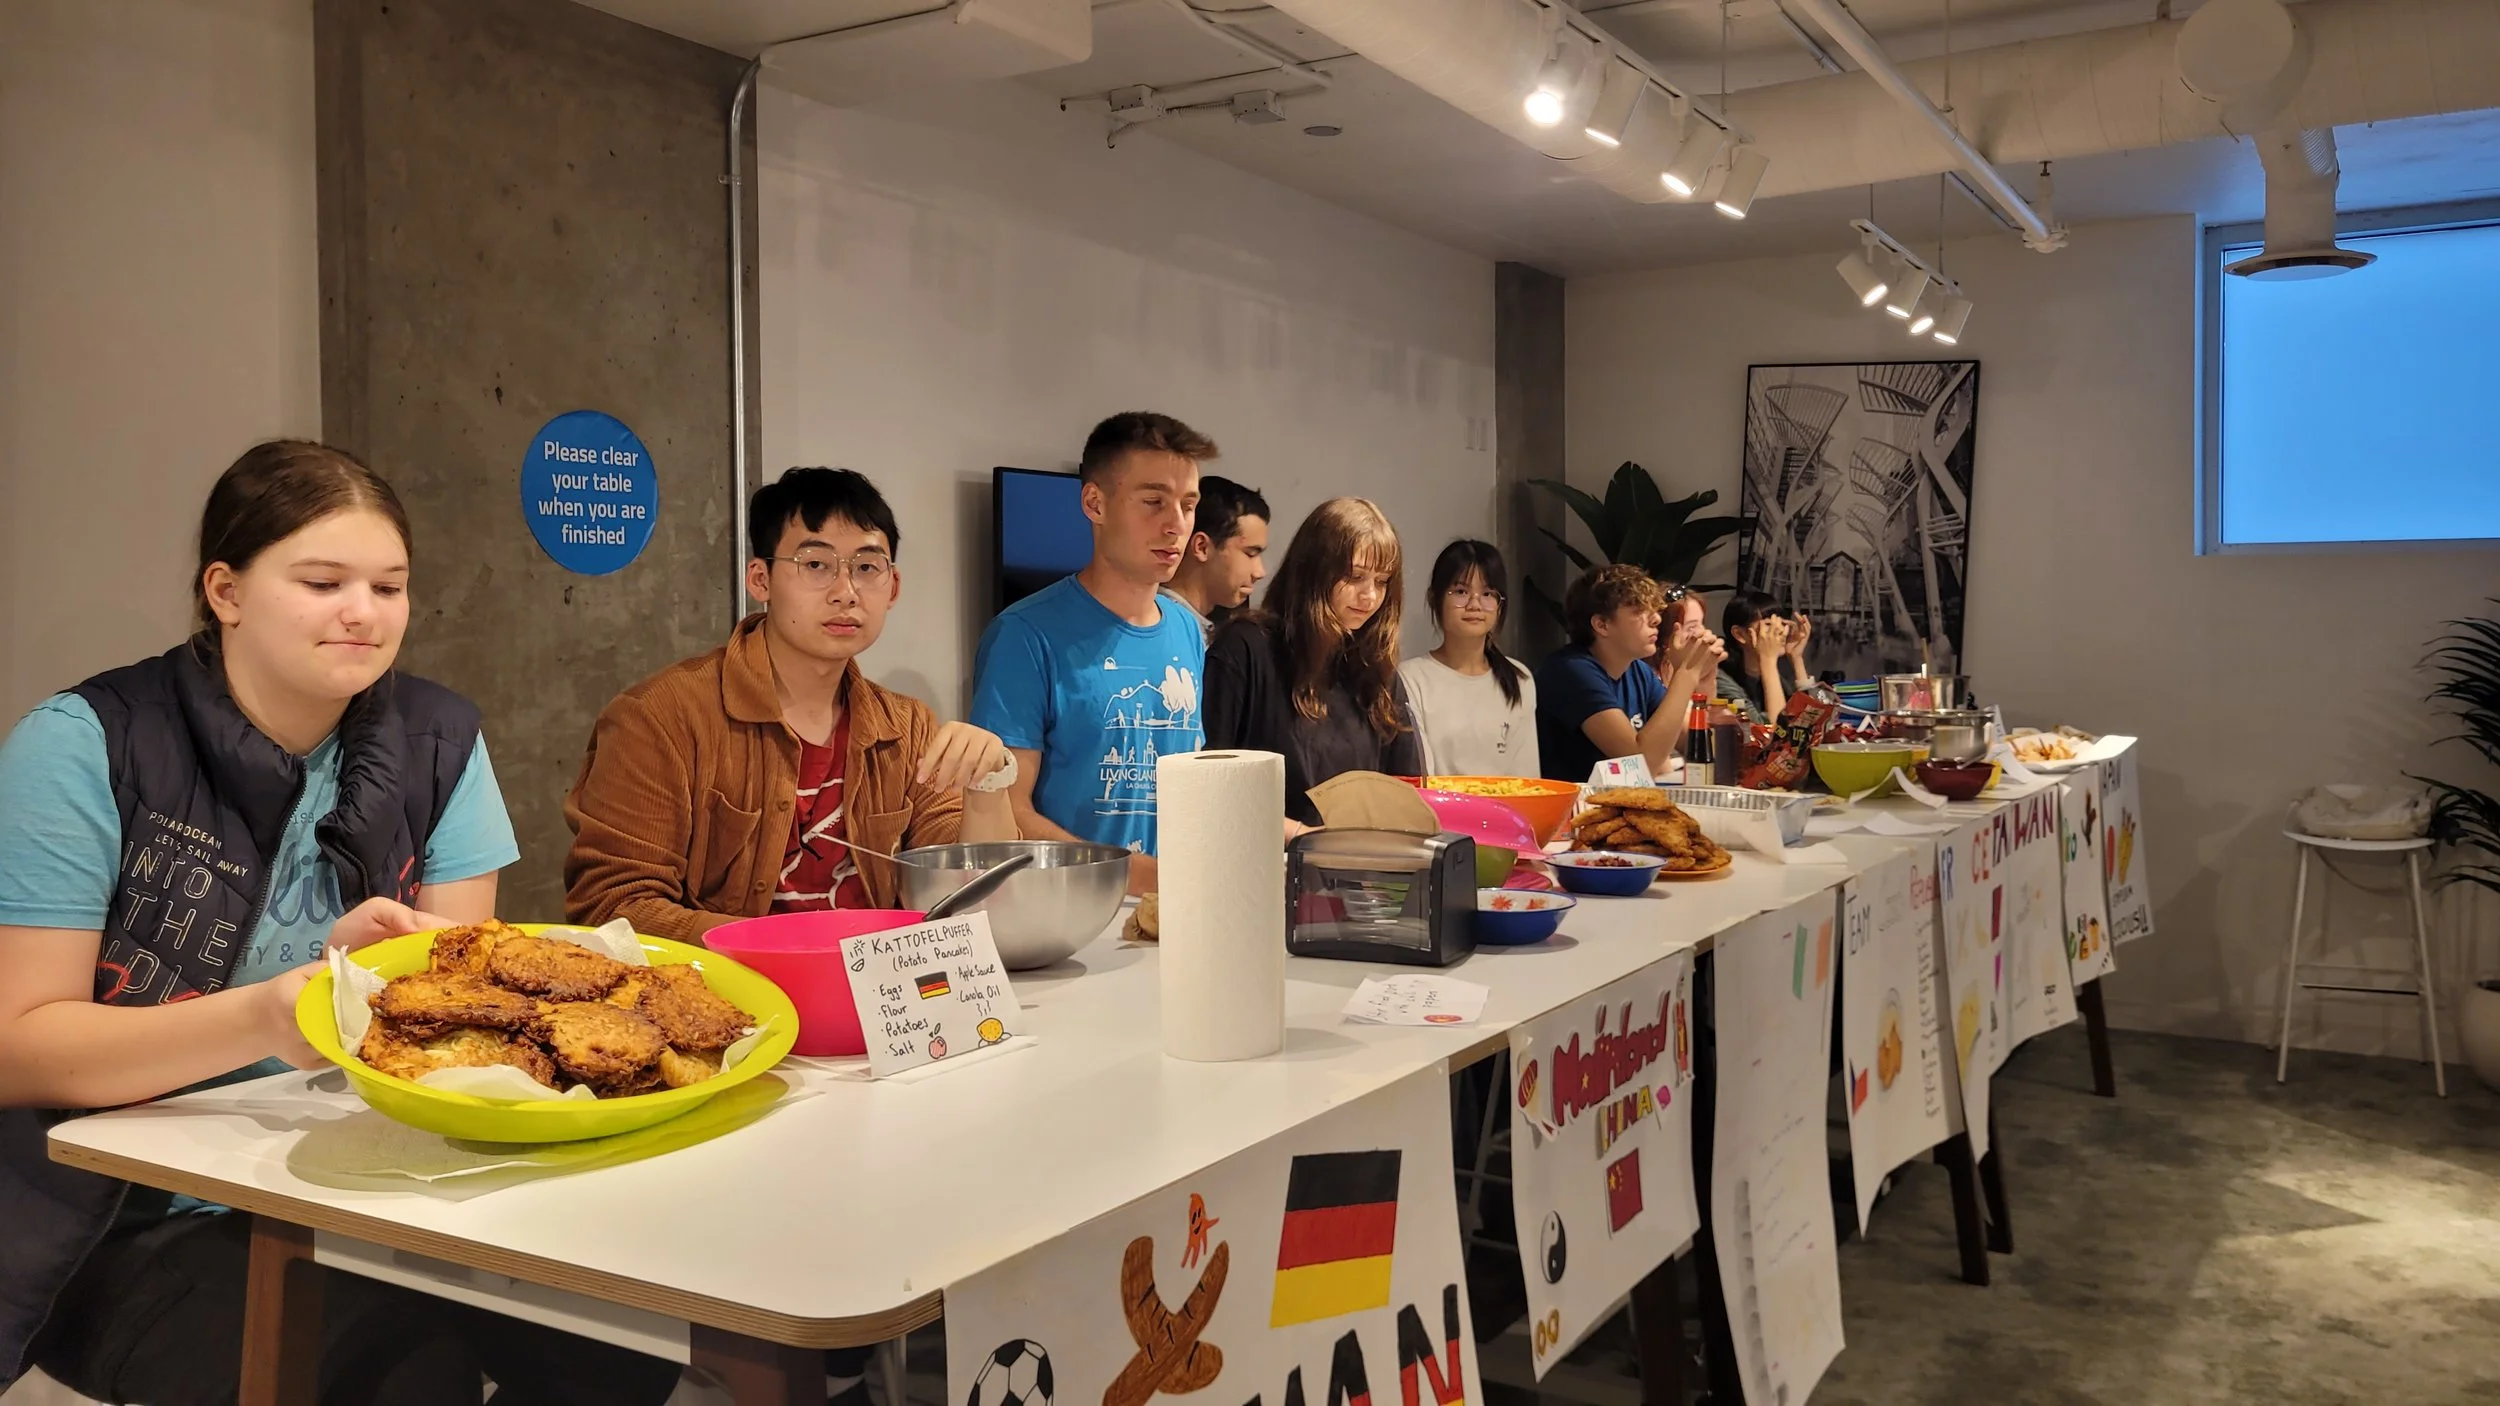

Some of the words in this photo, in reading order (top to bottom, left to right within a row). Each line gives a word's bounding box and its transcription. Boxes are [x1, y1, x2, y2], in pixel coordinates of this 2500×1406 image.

[544, 441, 597, 464] Please
[601, 447, 639, 467] clear
[552, 473, 588, 493] your
[593, 473, 632, 493] table
[538, 497, 583, 517] when
[588, 502, 616, 522] you
[621, 505, 646, 519] are
[561, 524, 625, 545] finished
[121, 841, 213, 899] INTO
[187, 845, 211, 864] SAIL
[217, 860, 249, 877] AWAY
[124, 887, 237, 967] THE
[892, 954, 928, 972] (Potato
[878, 984, 904, 1001] Eggs
[986, 985, 1001, 998] Oil
[880, 1005, 908, 1019] Flour
[885, 1018, 929, 1038] Potatoes
[888, 1041, 915, 1057] Salt
